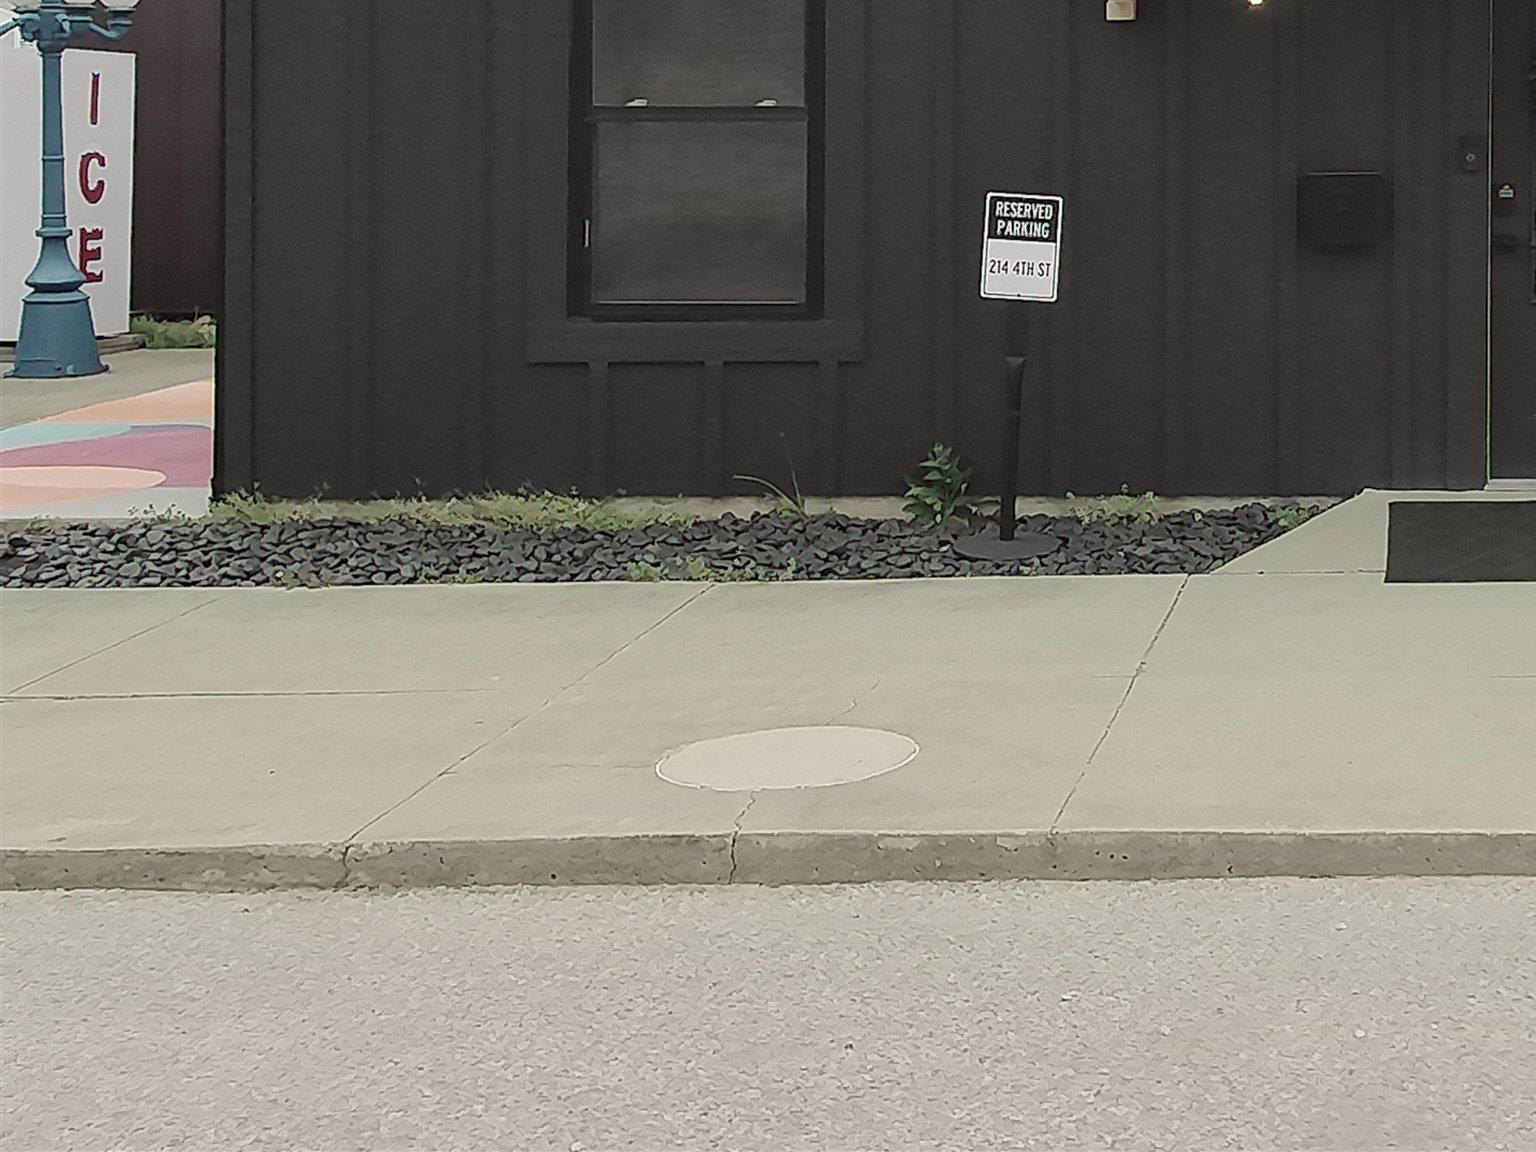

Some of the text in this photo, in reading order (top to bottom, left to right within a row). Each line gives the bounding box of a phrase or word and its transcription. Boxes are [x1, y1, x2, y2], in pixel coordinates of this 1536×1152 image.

[79, 71, 107, 283] ICE
[995, 201, 1053, 220] RESERVED
[996, 219, 1050, 238] PARKING
[989, 259, 1051, 277] 214 4TH ST
